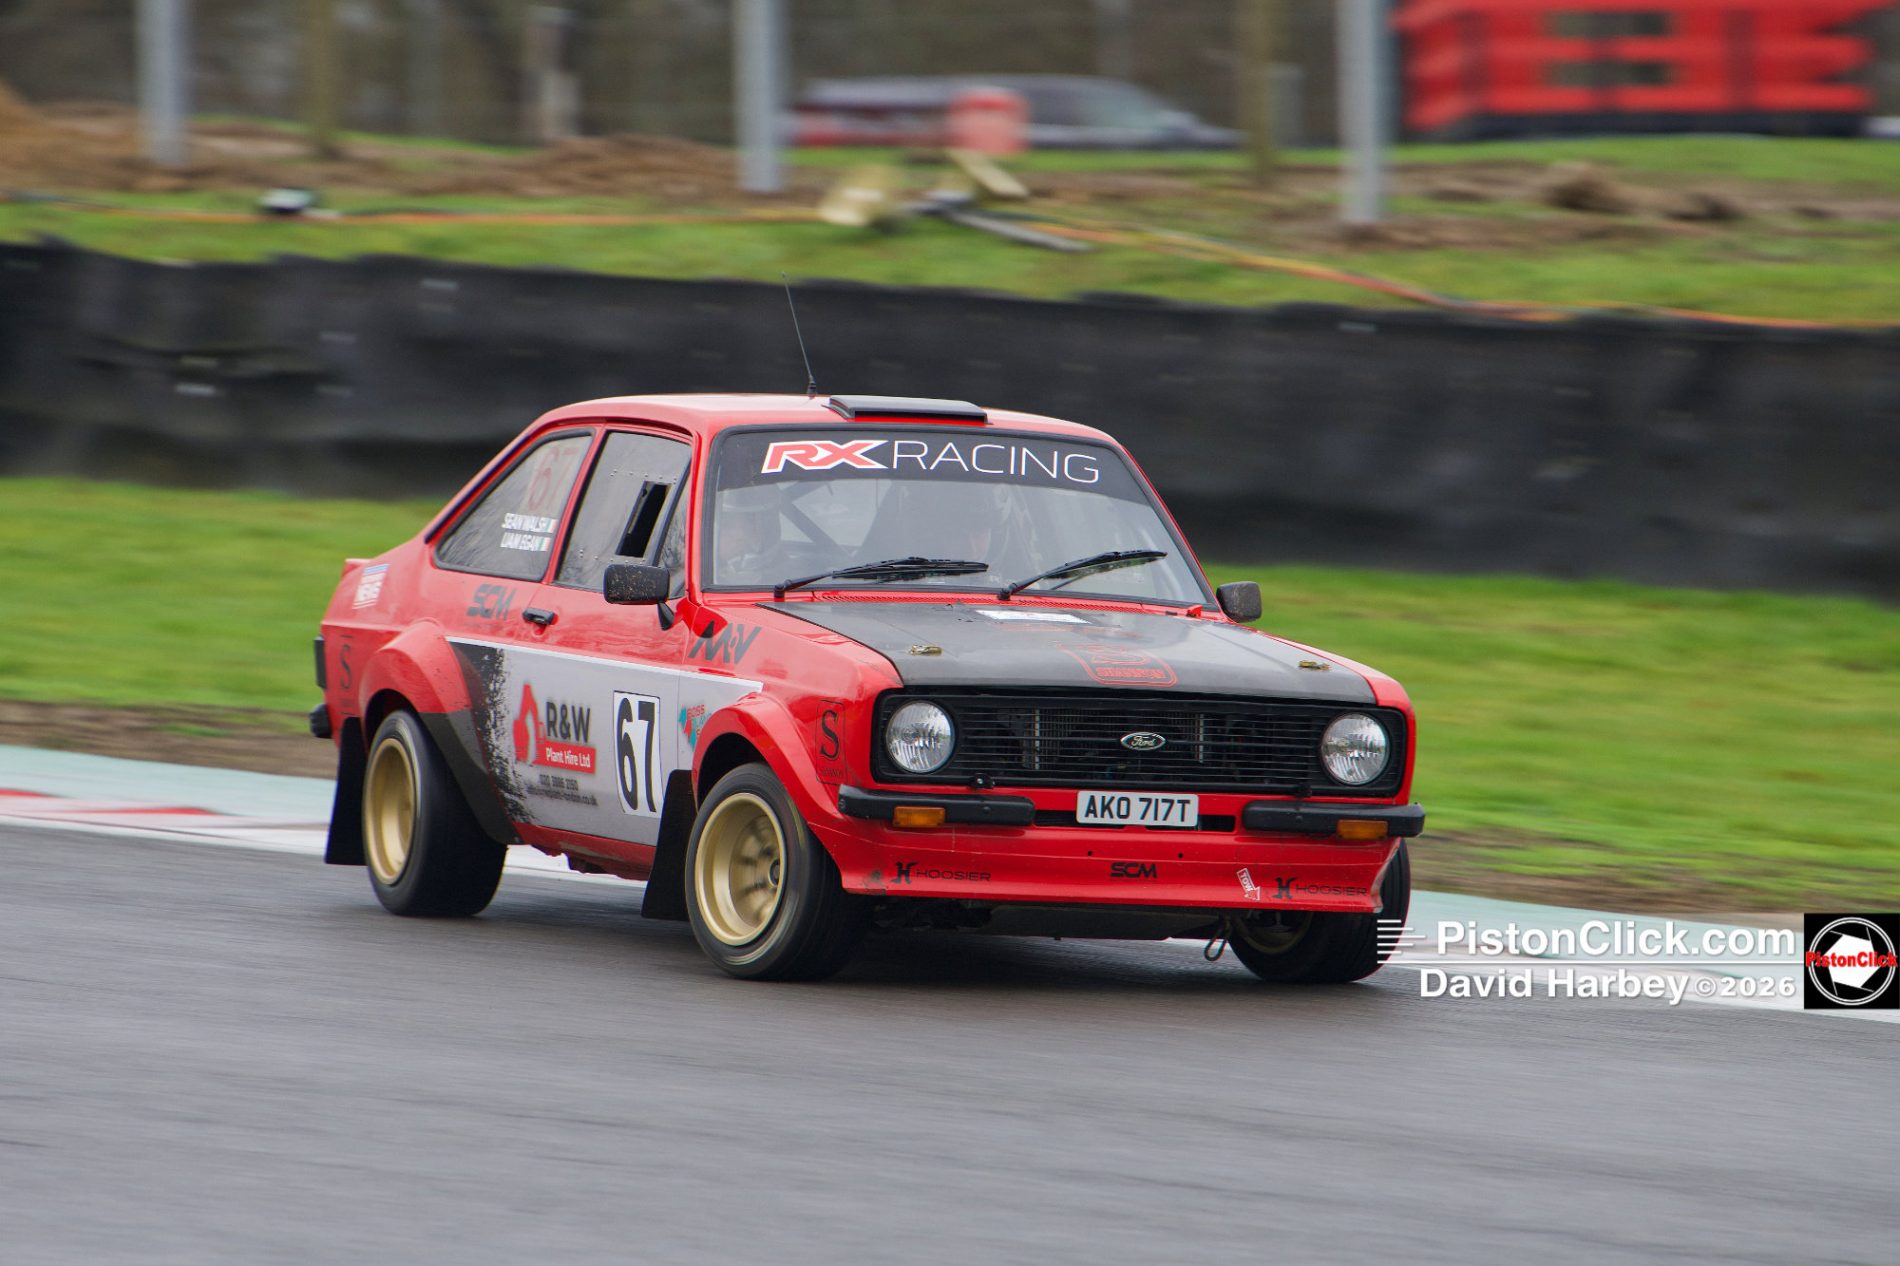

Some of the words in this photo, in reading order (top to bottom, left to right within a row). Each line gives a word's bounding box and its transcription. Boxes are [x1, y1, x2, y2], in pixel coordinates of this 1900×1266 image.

[761, 440, 888, 473] RX
[893, 440, 1099, 483] RACING
[546, 701, 591, 744] R&W
[820, 709, 840, 759] S
[545, 747, 565, 764] Plant
[564, 750, 579, 766] Hire
[579, 752, 591, 768] Ltd
[617, 697, 657, 813] 67
[1084, 794, 1131, 819] AKO
[1138, 797, 1191, 823] 717T
[916, 868, 991, 882] HOOSIER
[1110, 861, 1157, 879] SCM
[1240, 871, 1255, 893] TOW
[1296, 883, 1368, 897] HOOSIER
